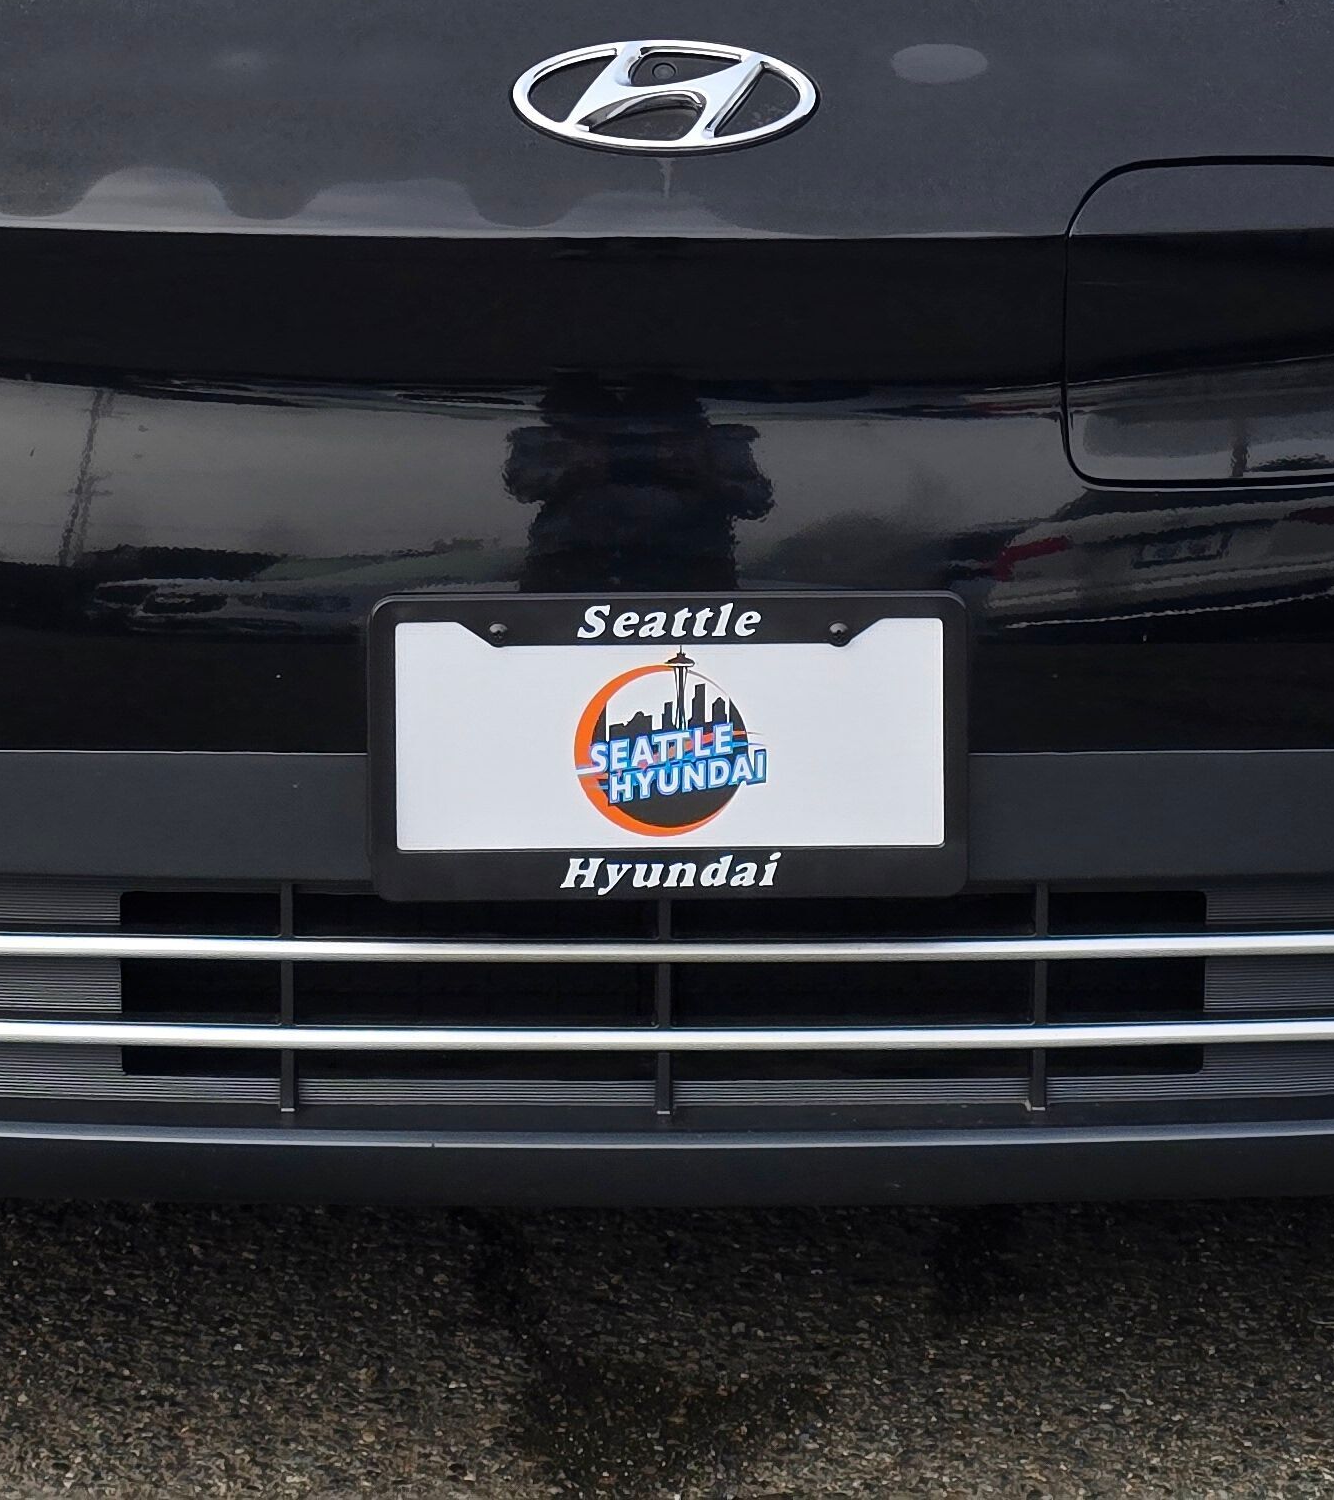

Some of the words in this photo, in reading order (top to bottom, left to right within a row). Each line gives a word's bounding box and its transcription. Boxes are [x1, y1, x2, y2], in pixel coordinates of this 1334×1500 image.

[577, 602, 762, 638] Seattle
[589, 722, 735, 774] SEATTLE
[609, 748, 767, 804] HYUNDAI
[560, 852, 782, 895] Hyundai
